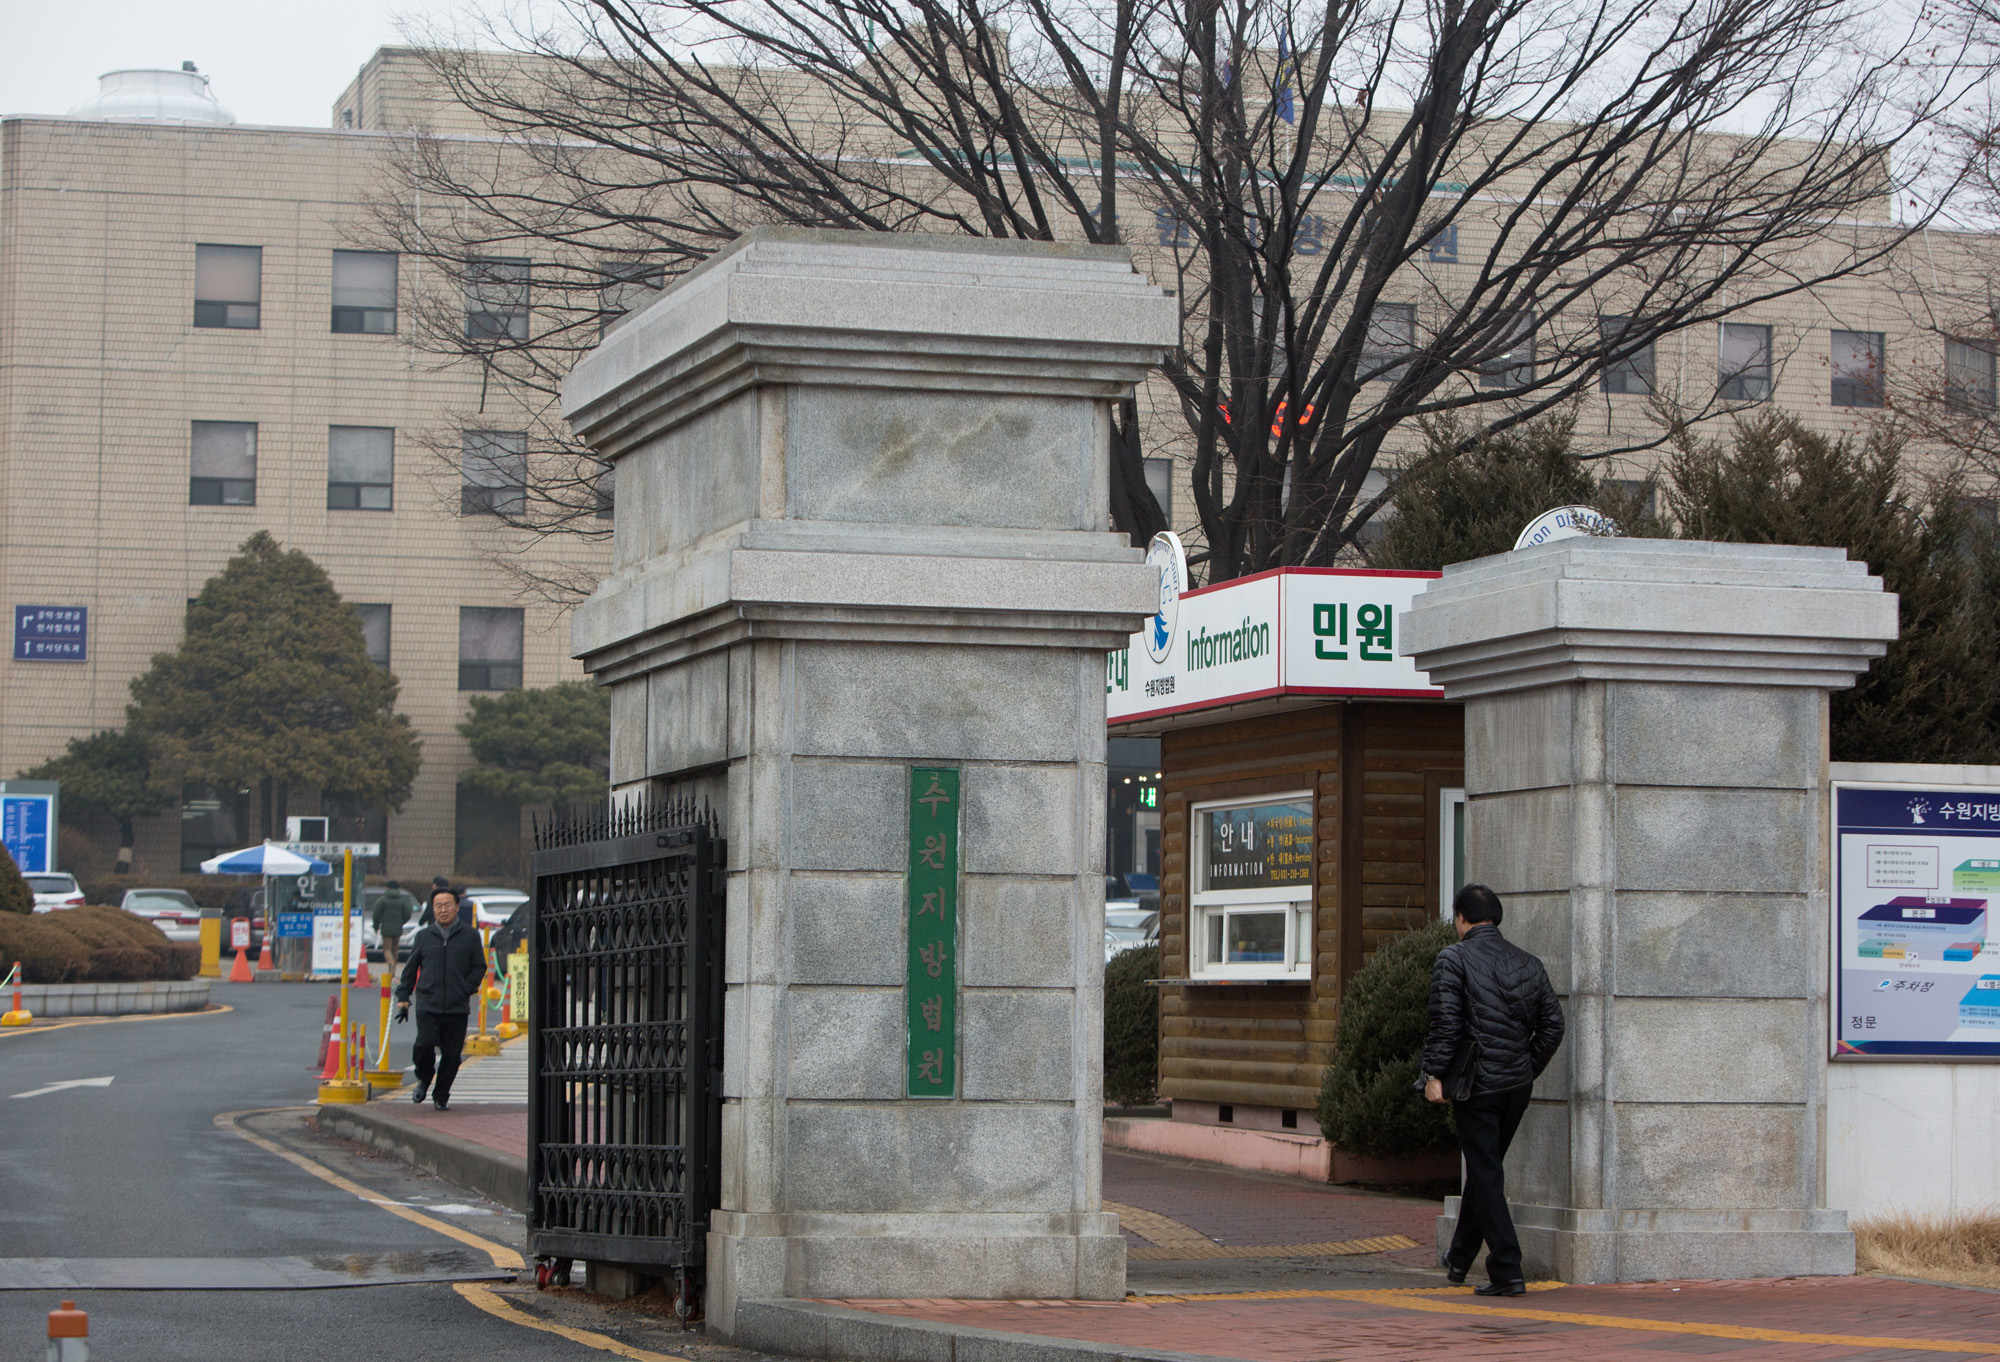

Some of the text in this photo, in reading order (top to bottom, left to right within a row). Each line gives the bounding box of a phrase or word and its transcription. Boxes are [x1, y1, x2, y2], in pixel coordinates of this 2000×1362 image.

[1313, 603, 1392, 661] 민원
[1187, 616, 1269, 672] Information
[1145, 675, 1175, 698] 수원지방법원
[1210, 861, 1263, 877] INFORMATION
[917, 781, 951, 1085] 수원지방법원
[1893, 980, 1934, 993] 주차장
[1851, 1015, 1877, 1030] 정문
